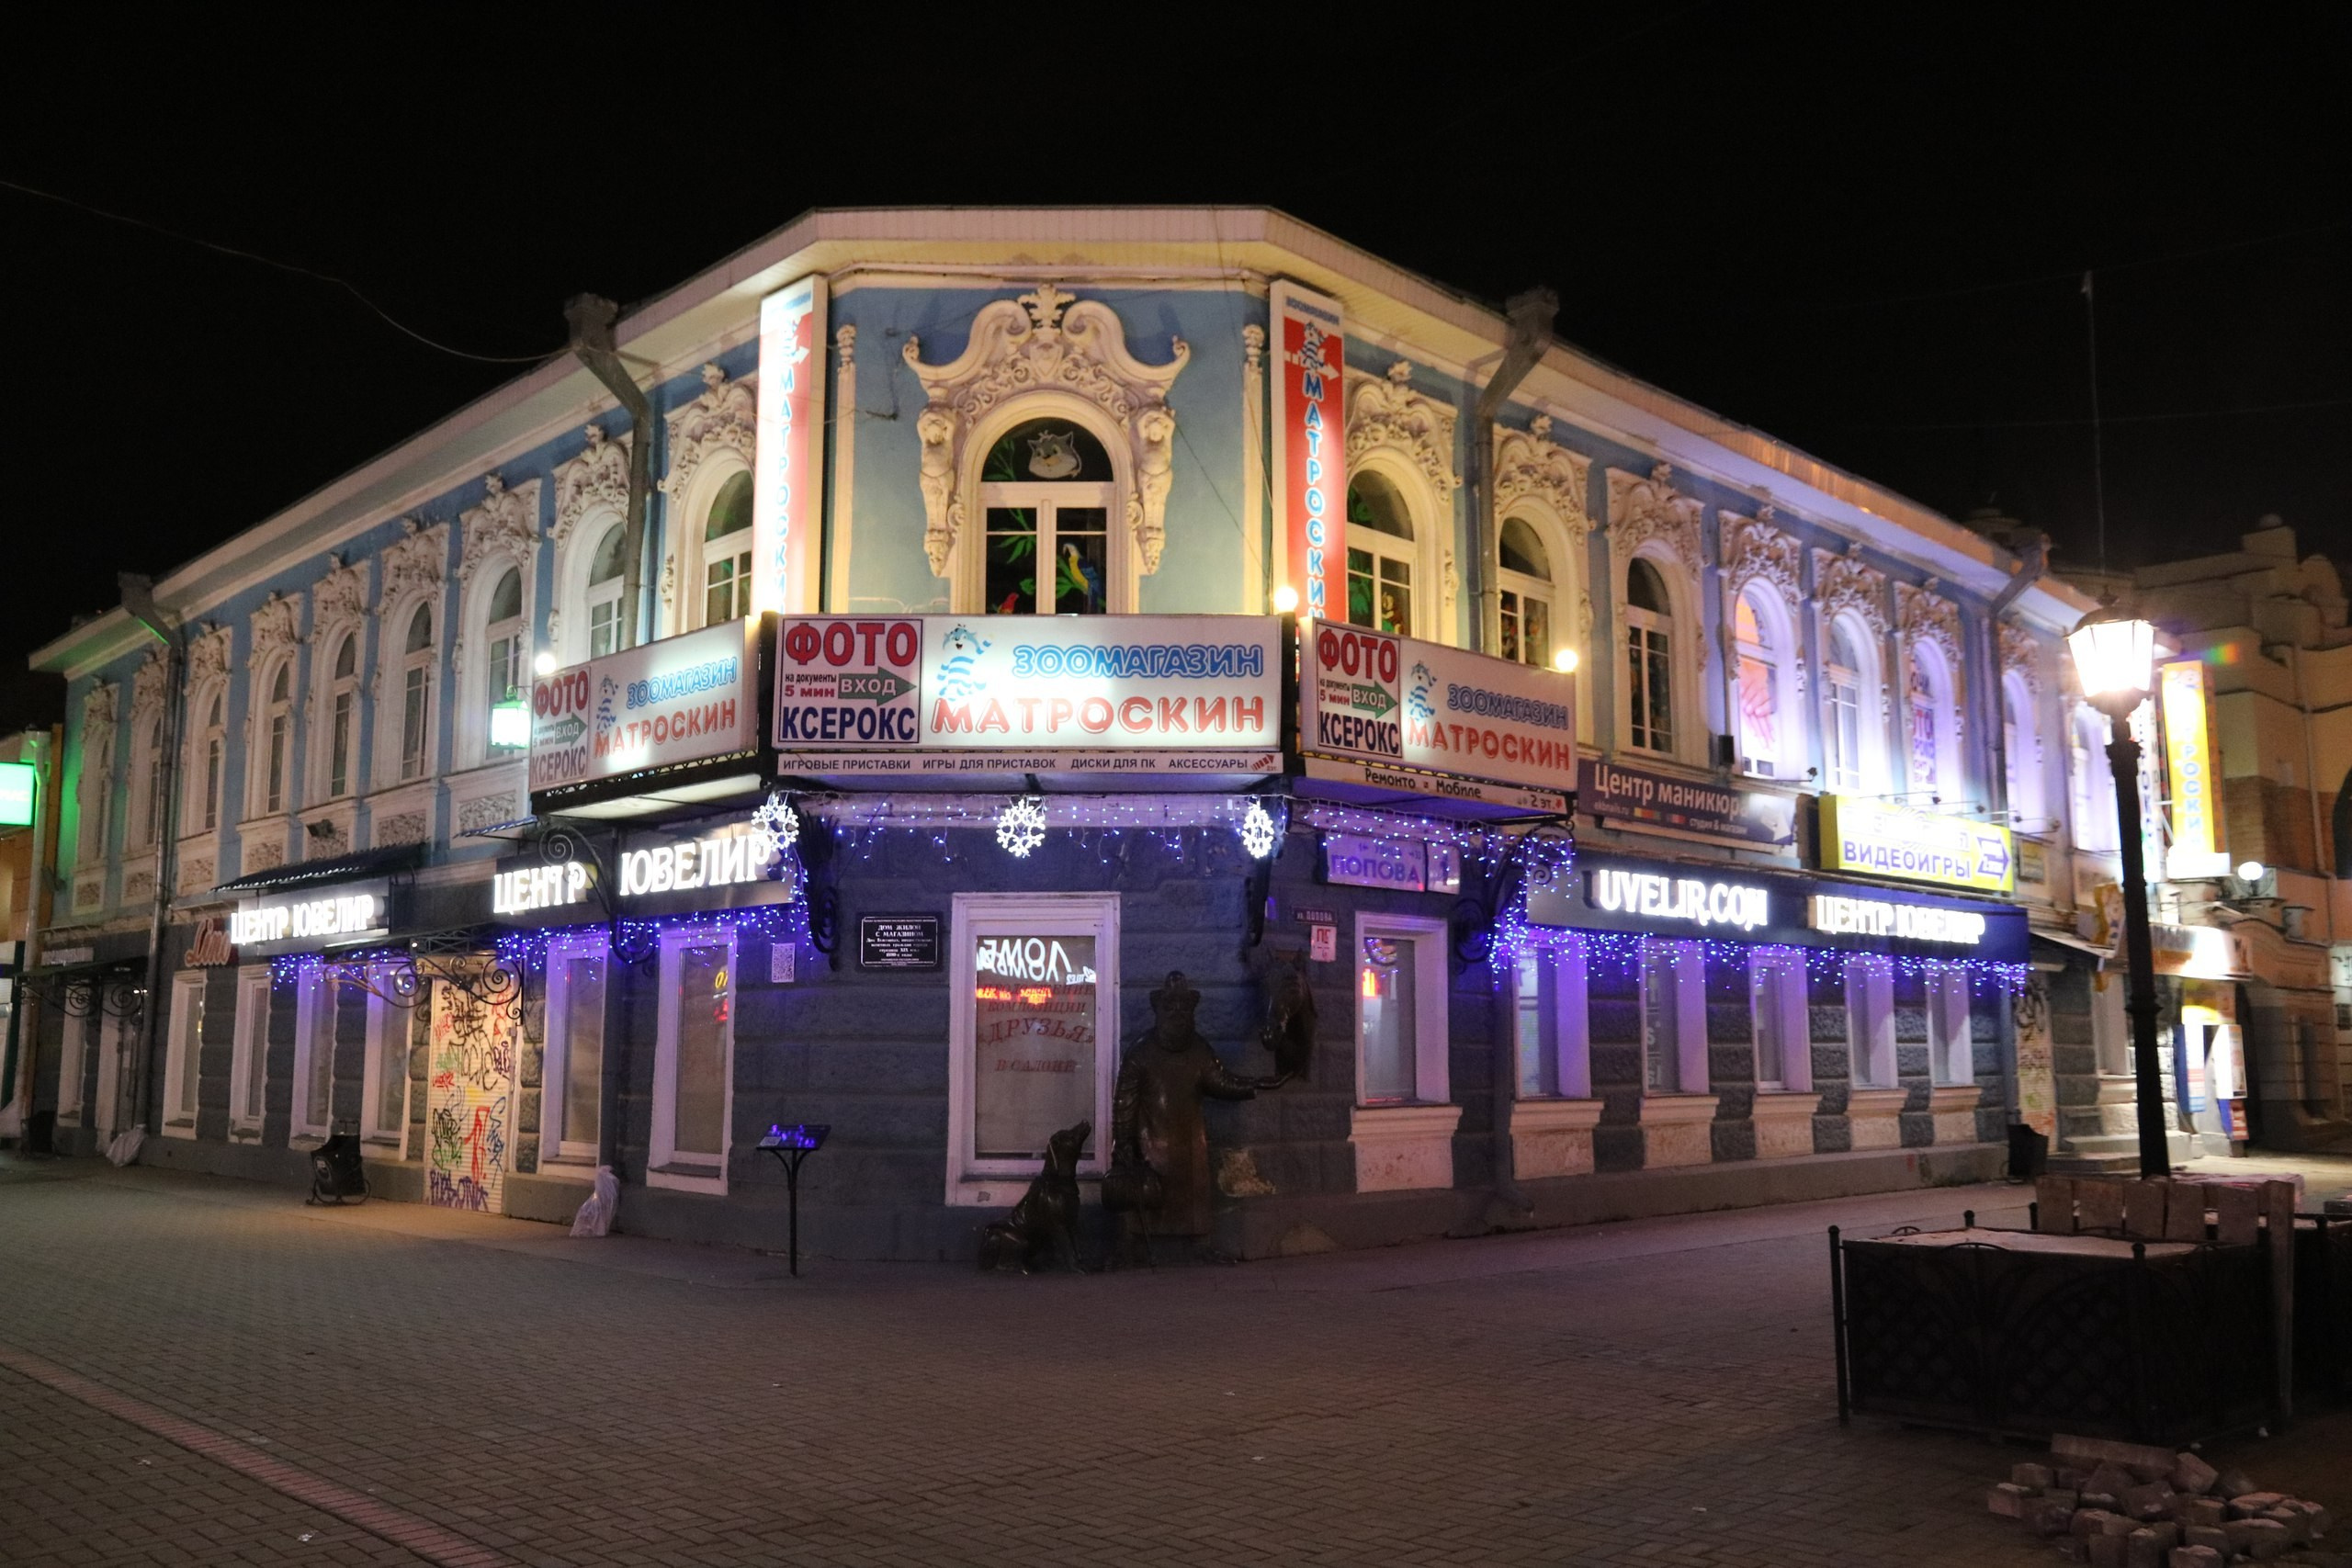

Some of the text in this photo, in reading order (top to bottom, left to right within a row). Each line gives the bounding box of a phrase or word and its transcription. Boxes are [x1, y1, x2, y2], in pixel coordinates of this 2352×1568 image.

[785, 622, 918, 667] ФОТО
[1012, 645, 1263, 678] ЗООМАГАЗИН
[1317, 628, 1397, 683] ФОТО
[535, 670, 589, 719] ФОТО
[626, 656, 737, 709] ЗООМАГАЗИН
[785, 685, 835, 697] 5 мин
[786, 673, 837, 685] на документы
[841, 679, 897, 696] ВХОД
[1319, 689, 1351, 705] 5 мин
[930, 696, 1264, 734] МАТРОСКИН
[1352, 688, 1386, 710] ВХОД
[1447, 683, 1569, 729] ЗООМАГАЗИН
[556, 722, 581, 738] ВХОД
[594, 698, 736, 759] МАТРОСКИН
[782, 706, 916, 740] КСЕРОКС
[1319, 712, 1399, 755] КСЕРОКС
[1408, 717, 1570, 771] МАТРОСКИН
[531, 746, 586, 784] КСЕРОКС
[783, 758, 1248, 770] ИГРОВЫЕ ПРИСТАВКИ ИГРЫ ДЛЯ ПРИСТАВОК ДИСКИ ДЛЯ ПК АКСЕССУАРЫ
[1530, 793, 1539, 807] 2
[1594, 763, 1750, 821] Центр маникюра
[493, 832, 771, 915] ЦЕНТР ЮВЕЛИР
[1331, 854, 1420, 884] ПОПОВА
[1844, 840, 1971, 878] ВИДЕОИГРЫ
[1600, 869, 1768, 931] UVELIR.COM
[1815, 895, 1894, 934] ЦЕНТР
[231, 895, 375, 945] ЦЕНТР ЮВЕЛИР
[995, 1059, 1007, 1072] В
